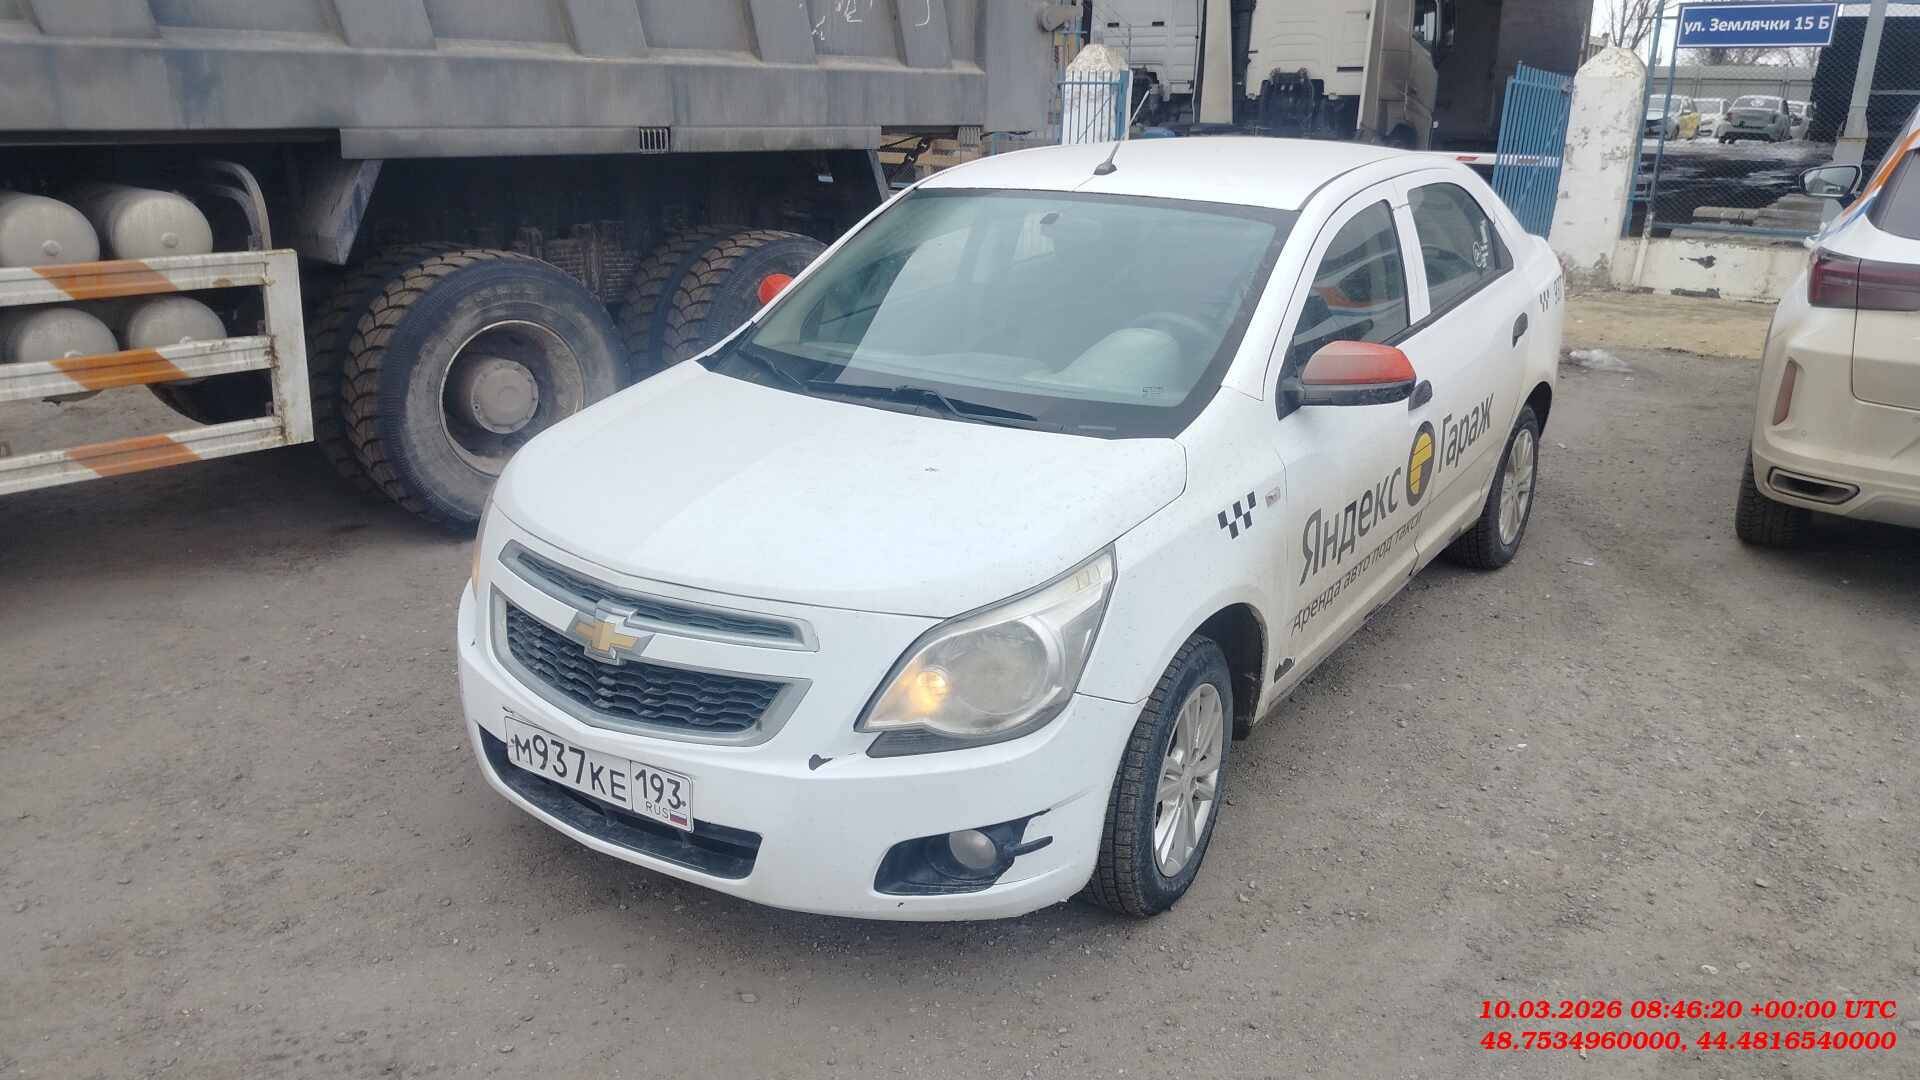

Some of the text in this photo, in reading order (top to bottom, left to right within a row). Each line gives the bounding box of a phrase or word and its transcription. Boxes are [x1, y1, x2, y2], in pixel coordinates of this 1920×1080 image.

[1684, 15, 1830, 35] ул. Землячки 15 Б
[1299, 393, 1494, 587] Яндекс Гараж
[1291, 579, 1342, 637] Аренда
[1343, 555, 1371, 590] авто
[1371, 537, 1393, 567] под
[635, 768, 682, 810] 193
[645, 802, 669, 818] RUS
